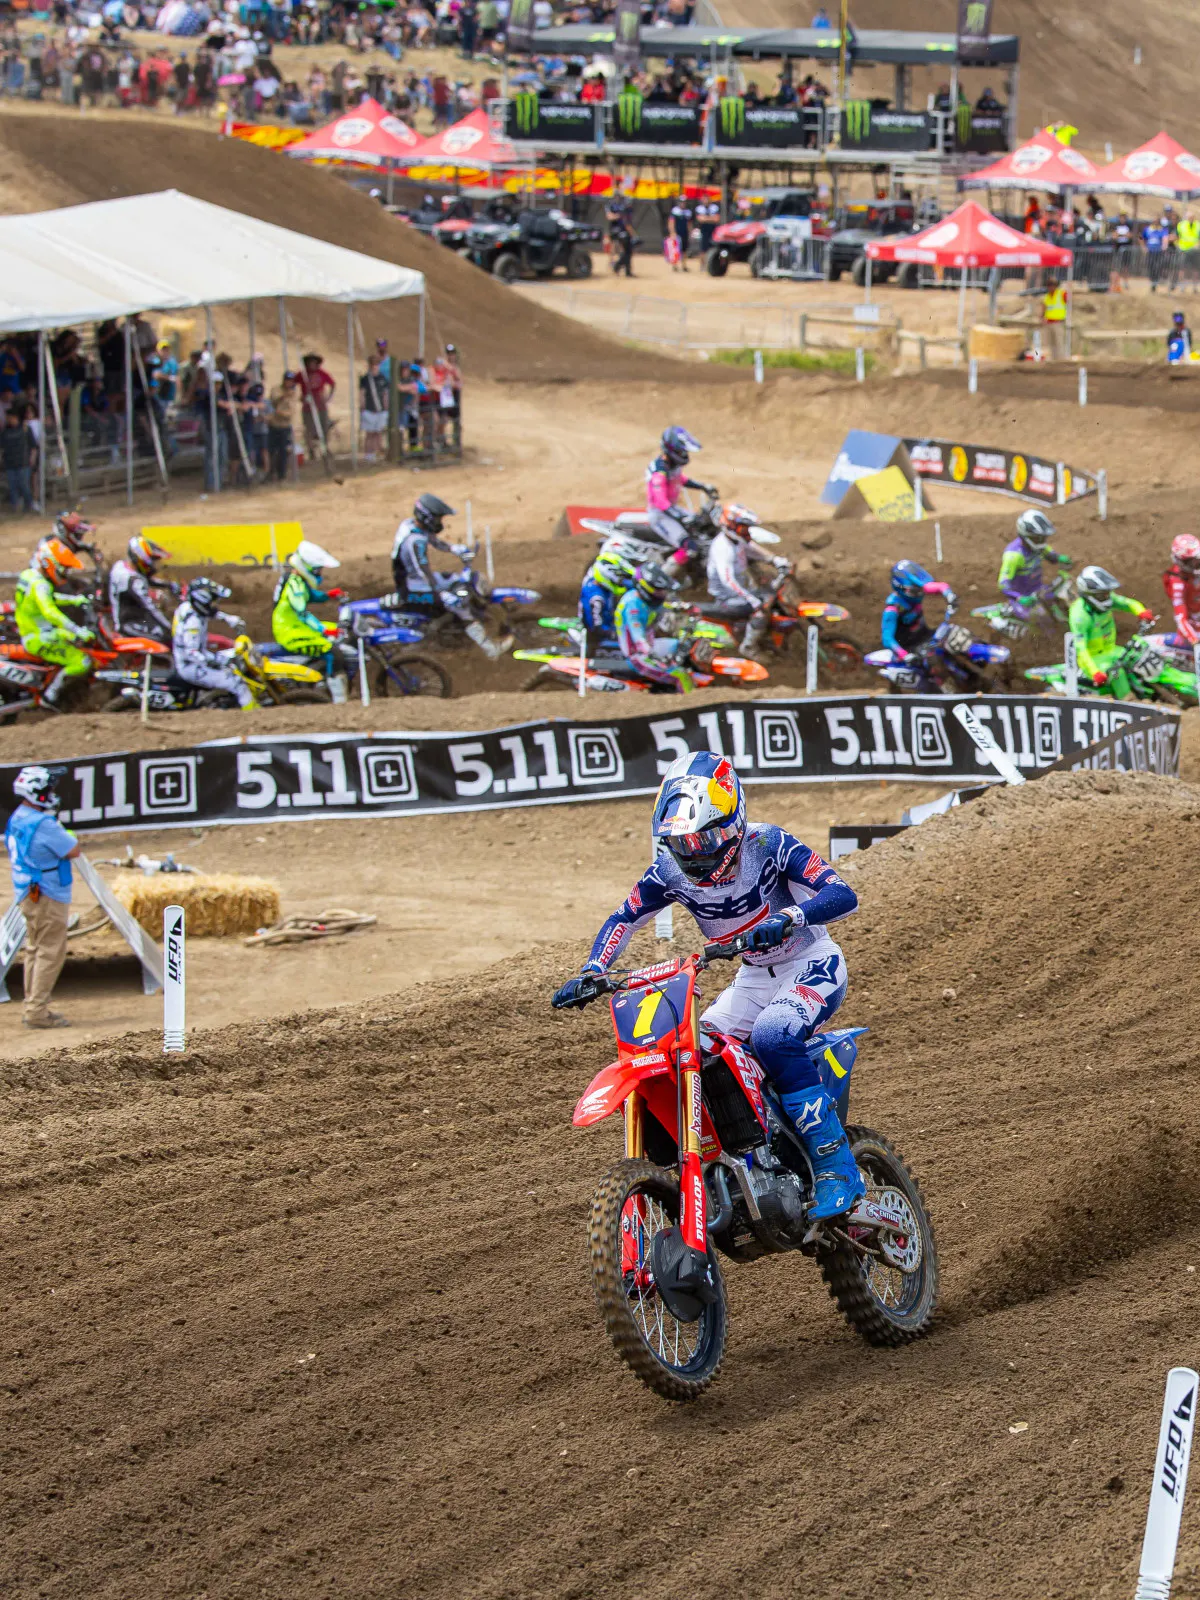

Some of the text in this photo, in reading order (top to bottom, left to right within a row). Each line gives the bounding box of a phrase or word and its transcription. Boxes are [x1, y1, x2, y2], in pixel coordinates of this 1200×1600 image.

[448, 729, 569, 797] 5.11
[649, 709, 754, 776] 511
[824, 705, 913, 766] 5.11
[971, 704, 1036, 768] 511
[57, 762, 136, 823] .11
[236, 748, 357, 810] 5.11
[710, 856, 730, 881] Red
[168, 936, 178, 982] UFO
[600, 922, 628, 966] HONDA
[631, 958, 677, 977] RENTHAL
[632, 988, 668, 1039] 1
[824, 1047, 848, 1079] 1
[693, 1175, 704, 1243] DUNLOP
[1161, 1419, 1182, 1498] UFO
